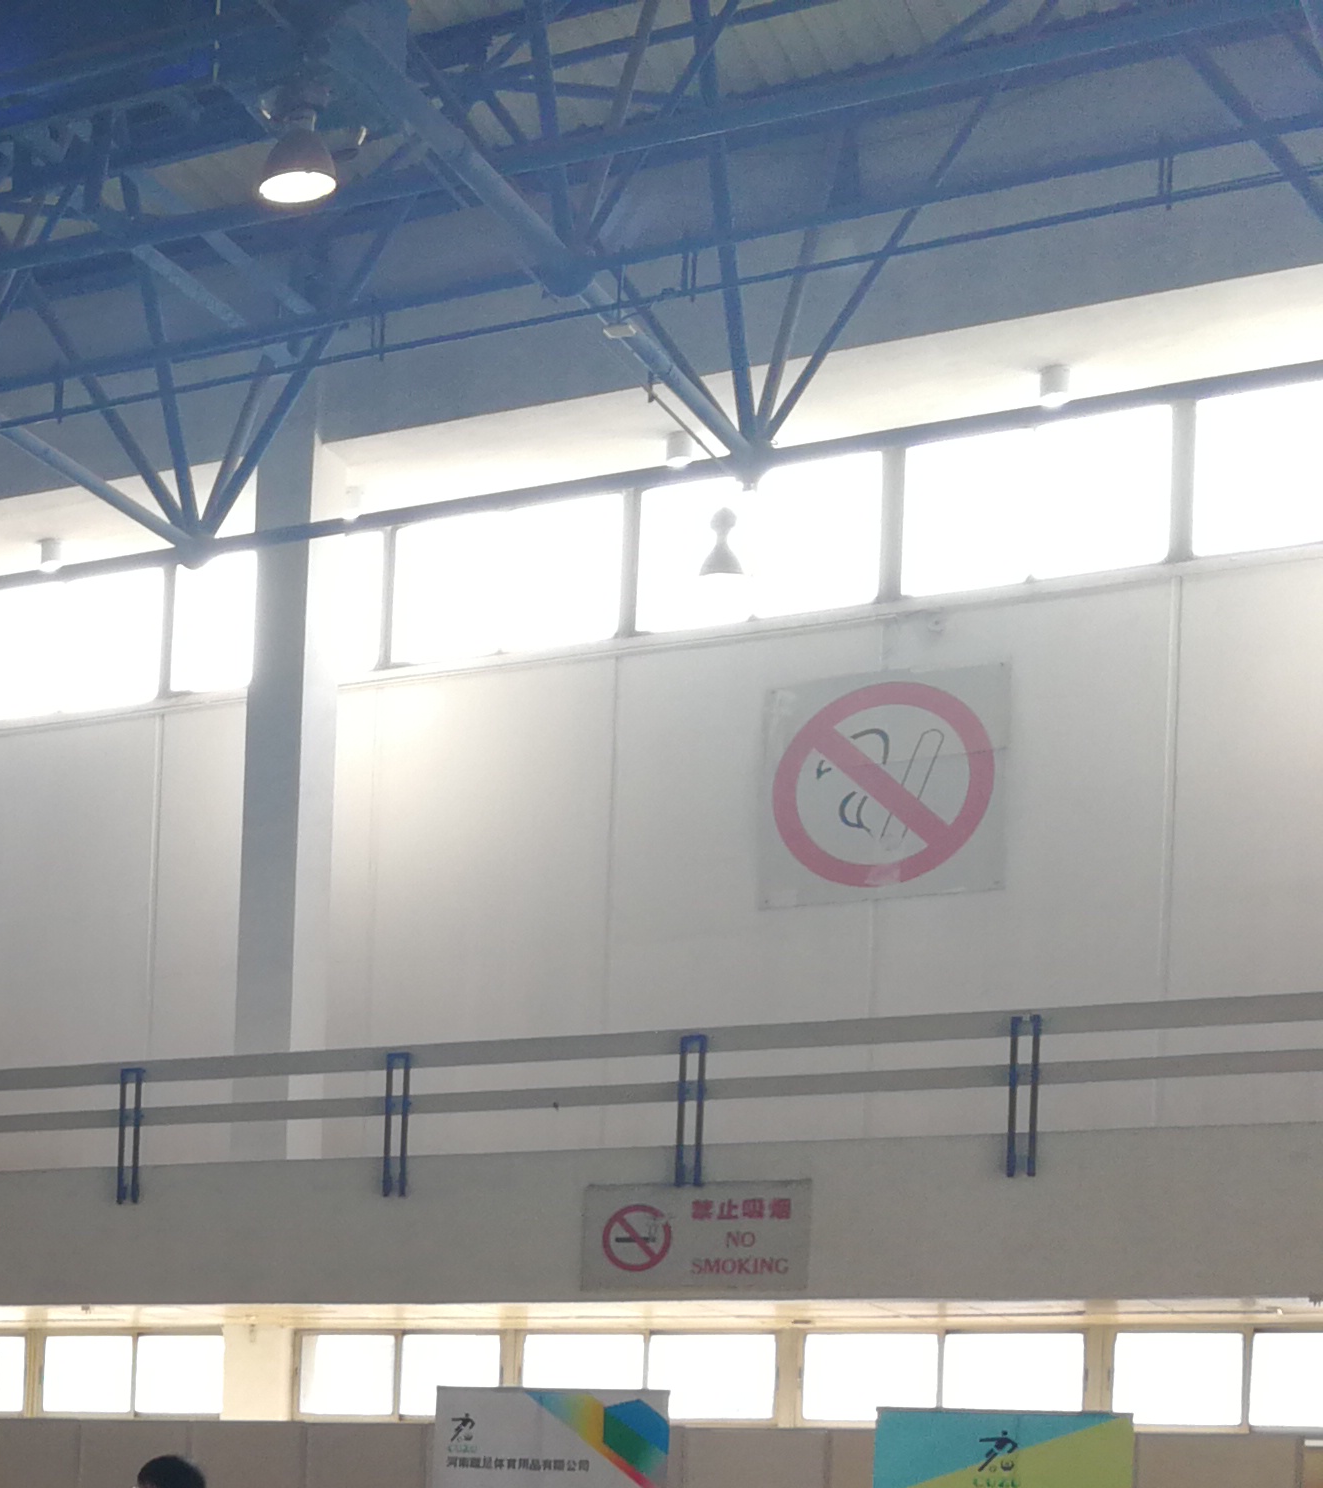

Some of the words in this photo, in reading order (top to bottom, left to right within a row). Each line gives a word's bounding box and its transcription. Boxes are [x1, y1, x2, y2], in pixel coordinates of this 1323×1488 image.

[691, 1197, 791, 1220] 禁止吸烟
[725, 1230, 756, 1249] NO
[691, 1257, 789, 1275] SMOKING
